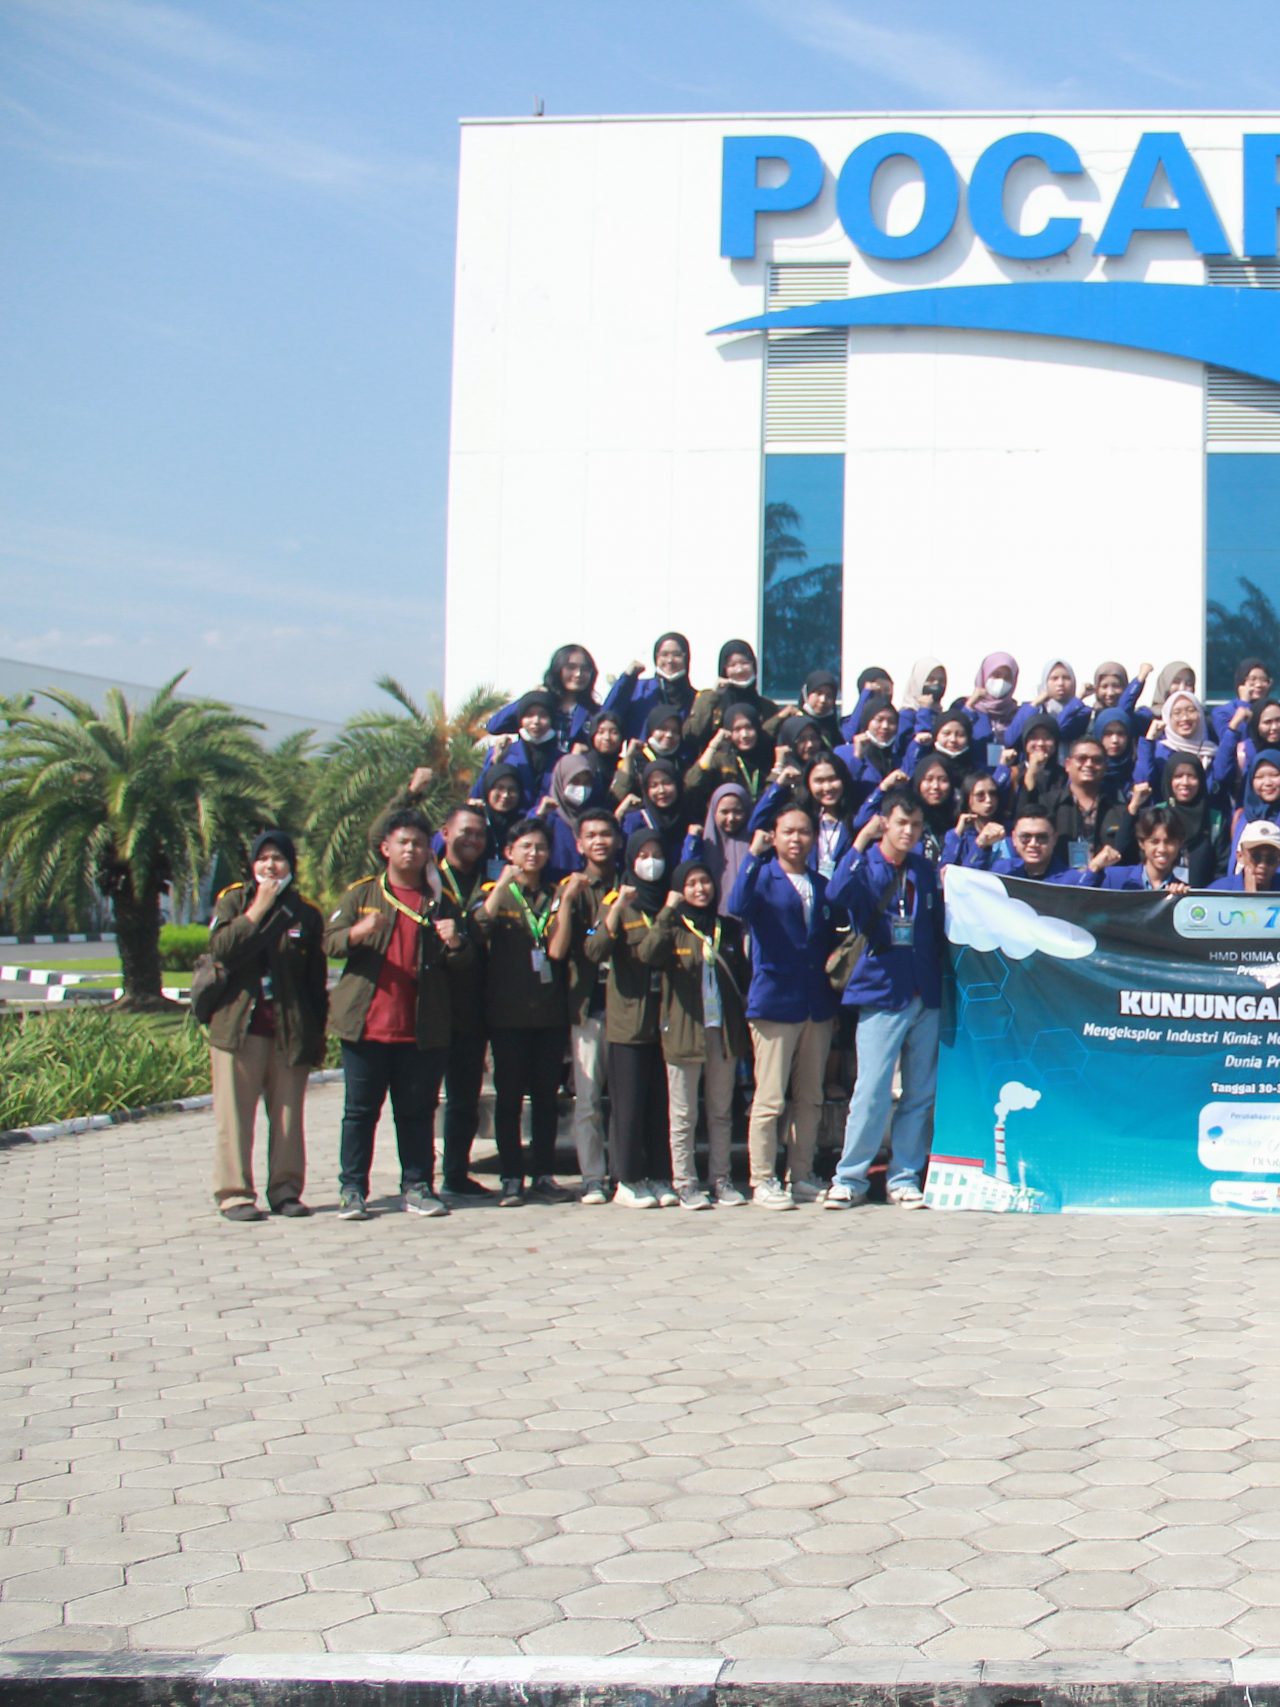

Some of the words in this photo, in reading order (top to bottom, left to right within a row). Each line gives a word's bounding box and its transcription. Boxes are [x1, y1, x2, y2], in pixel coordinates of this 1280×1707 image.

[1209, 951, 1239, 962] HMD
[1241, 951, 1275, 962] KIMIA
[1083, 1022, 1162, 1042] Mengeksplor
[1166, 1028, 1218, 1044] Industri
[1222, 1031, 1262, 1045] Kimia:
[1224, 1054, 1262, 1069] Dunia
[1211, 1082, 1256, 1095] Tanggal
